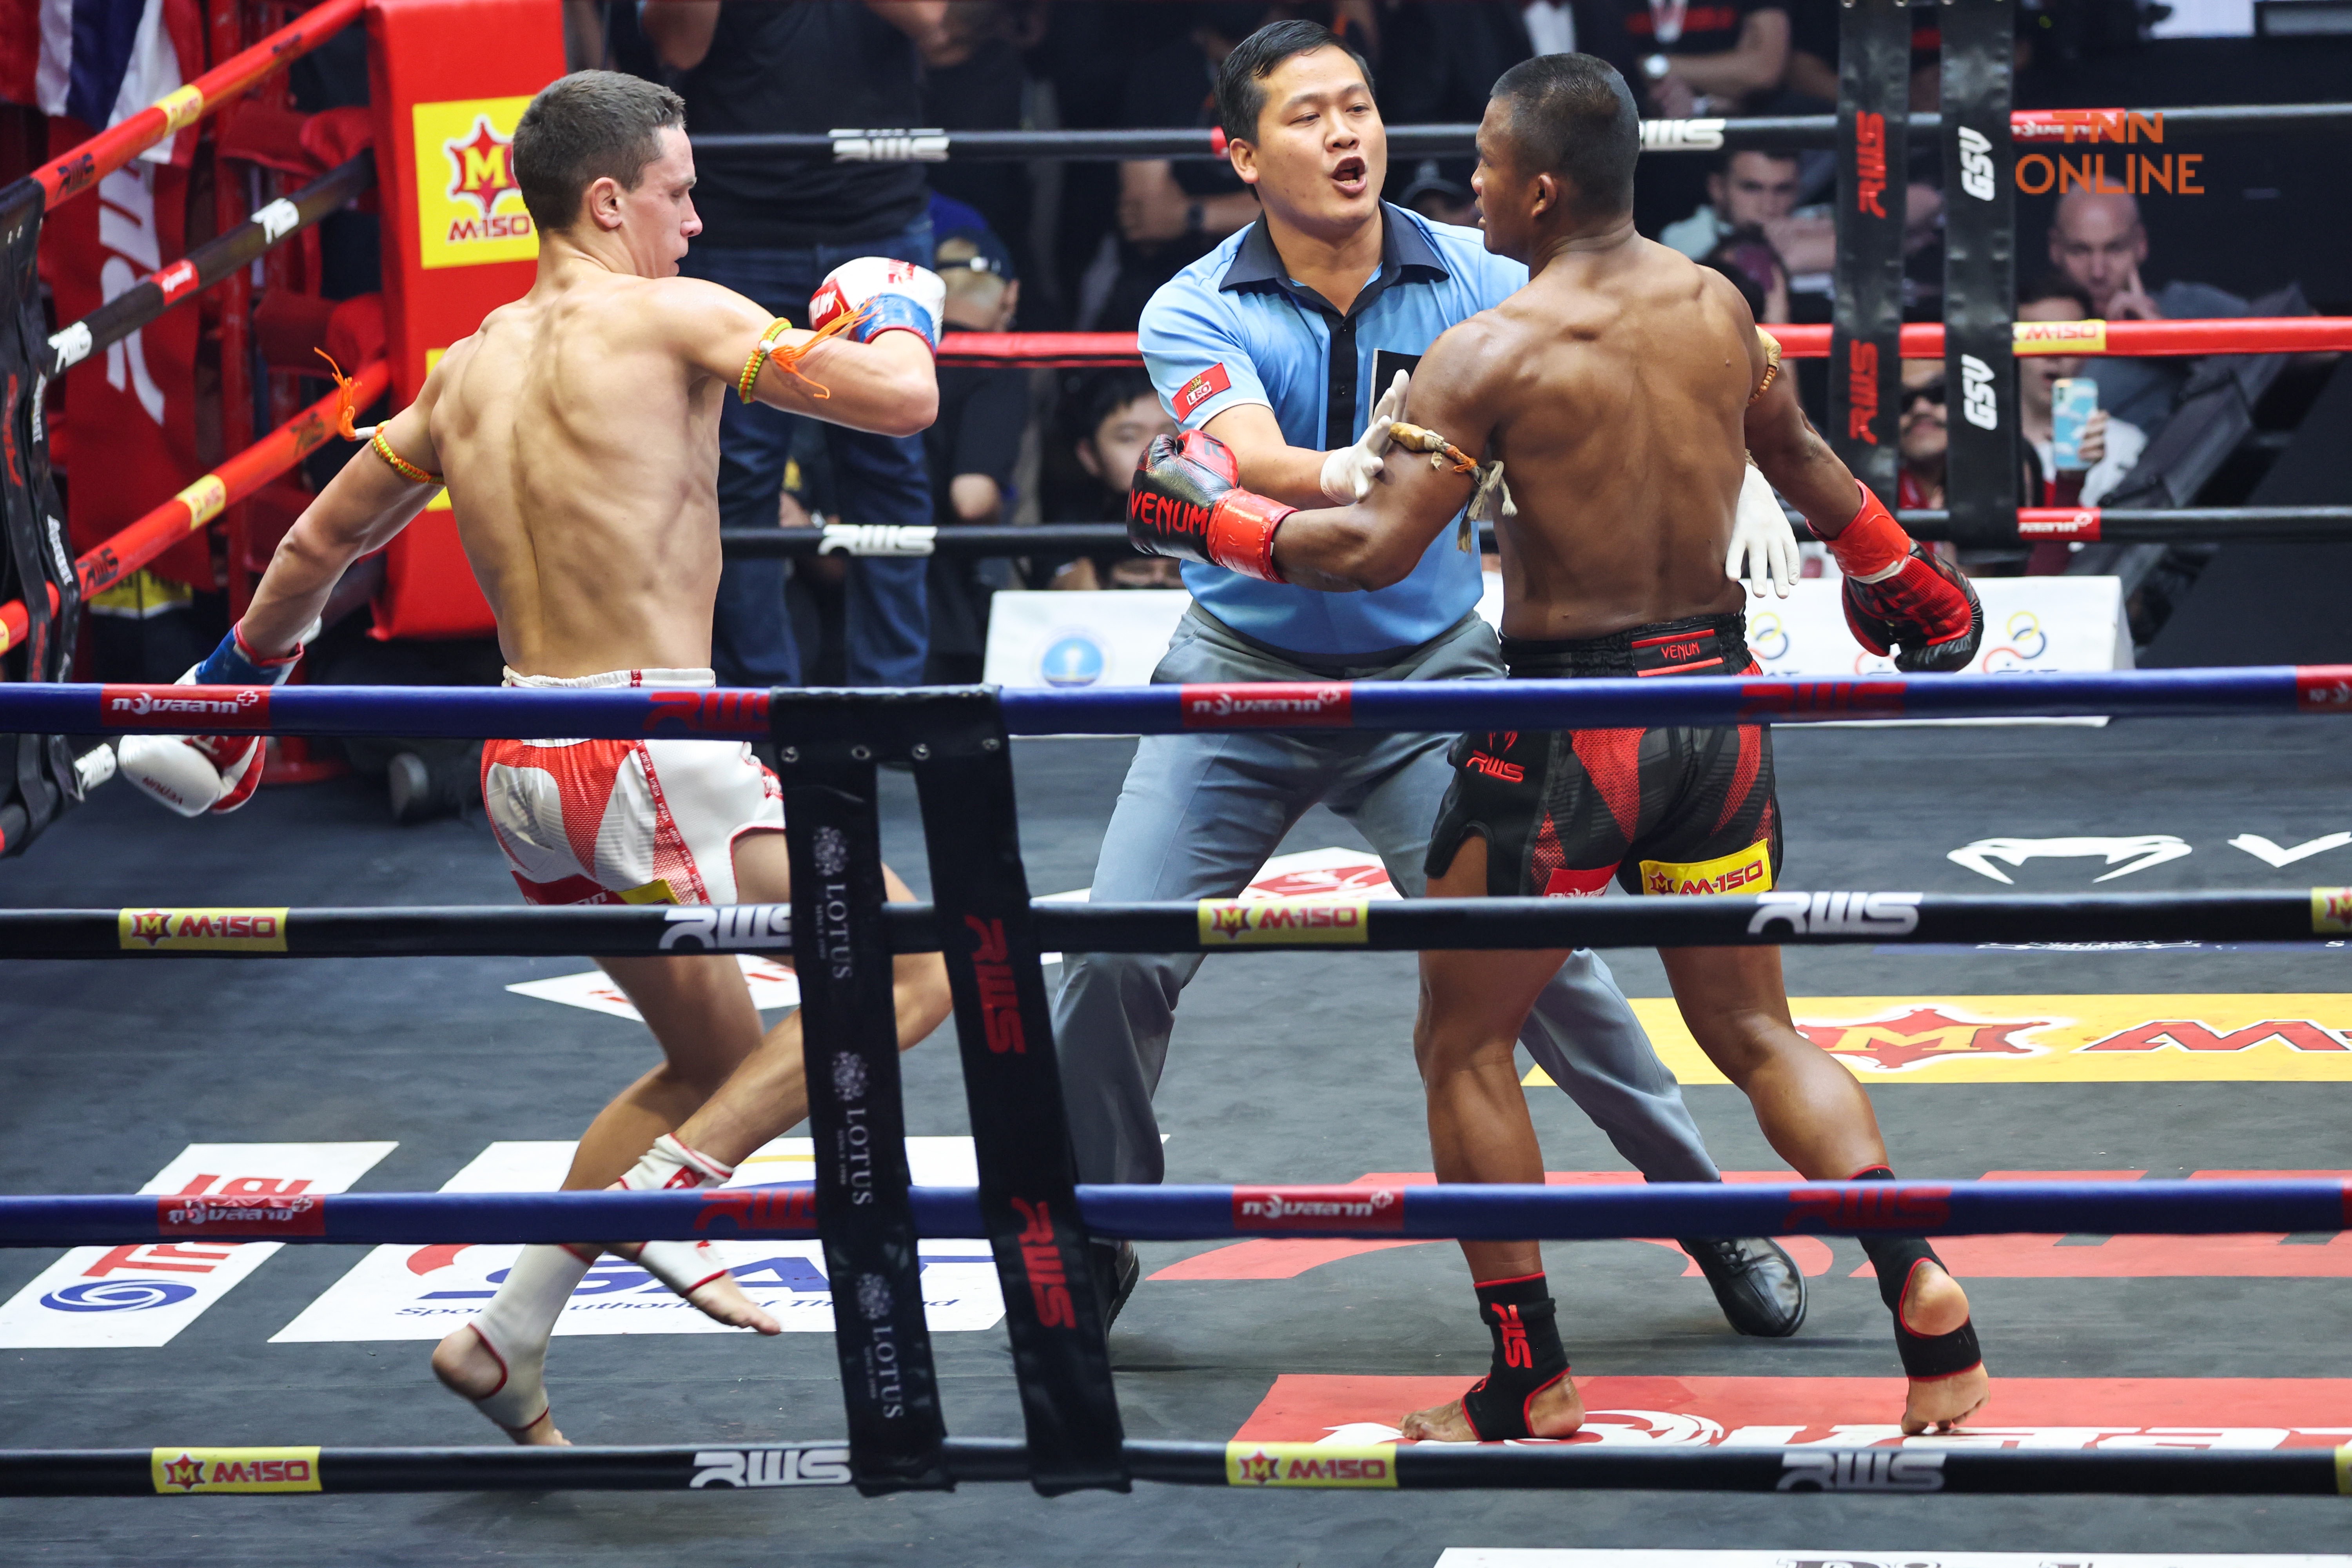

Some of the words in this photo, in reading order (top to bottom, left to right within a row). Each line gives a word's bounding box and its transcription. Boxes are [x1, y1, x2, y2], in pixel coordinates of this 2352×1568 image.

[1856, 110, 1887, 218] RWS
[1959, 126, 1994, 201] GSV
[448, 215, 530, 241] M-150
[1188, 384, 1210, 403] LEO
[1849, 339, 1878, 445] RWS
[1961, 354, 1998, 430] GSV
[1131, 488, 1209, 537] VENUM
[1661, 641, 1700, 661] VENUM
[1466, 749, 1525, 783] RWS
[1679, 860, 1764, 895] M-150
[177, 915, 276, 938] M-150
[826, 884, 853, 978] LOTUS
[1258, 906, 1358, 929] M-150
[1747, 892, 1924, 935] RWS
[964, 914, 1025, 1054] RWS
[846, 1107, 873, 1205] LOTUS
[1011, 1197, 1076, 1330] RWS
[873, 1326, 904, 1419] LOTUS
[213, 1461, 310, 1483] M-150
[691, 1450, 852, 1487] RWS
[1287, 1459, 1387, 1480] M-150
[1777, 1452, 1946, 1491] RWS
